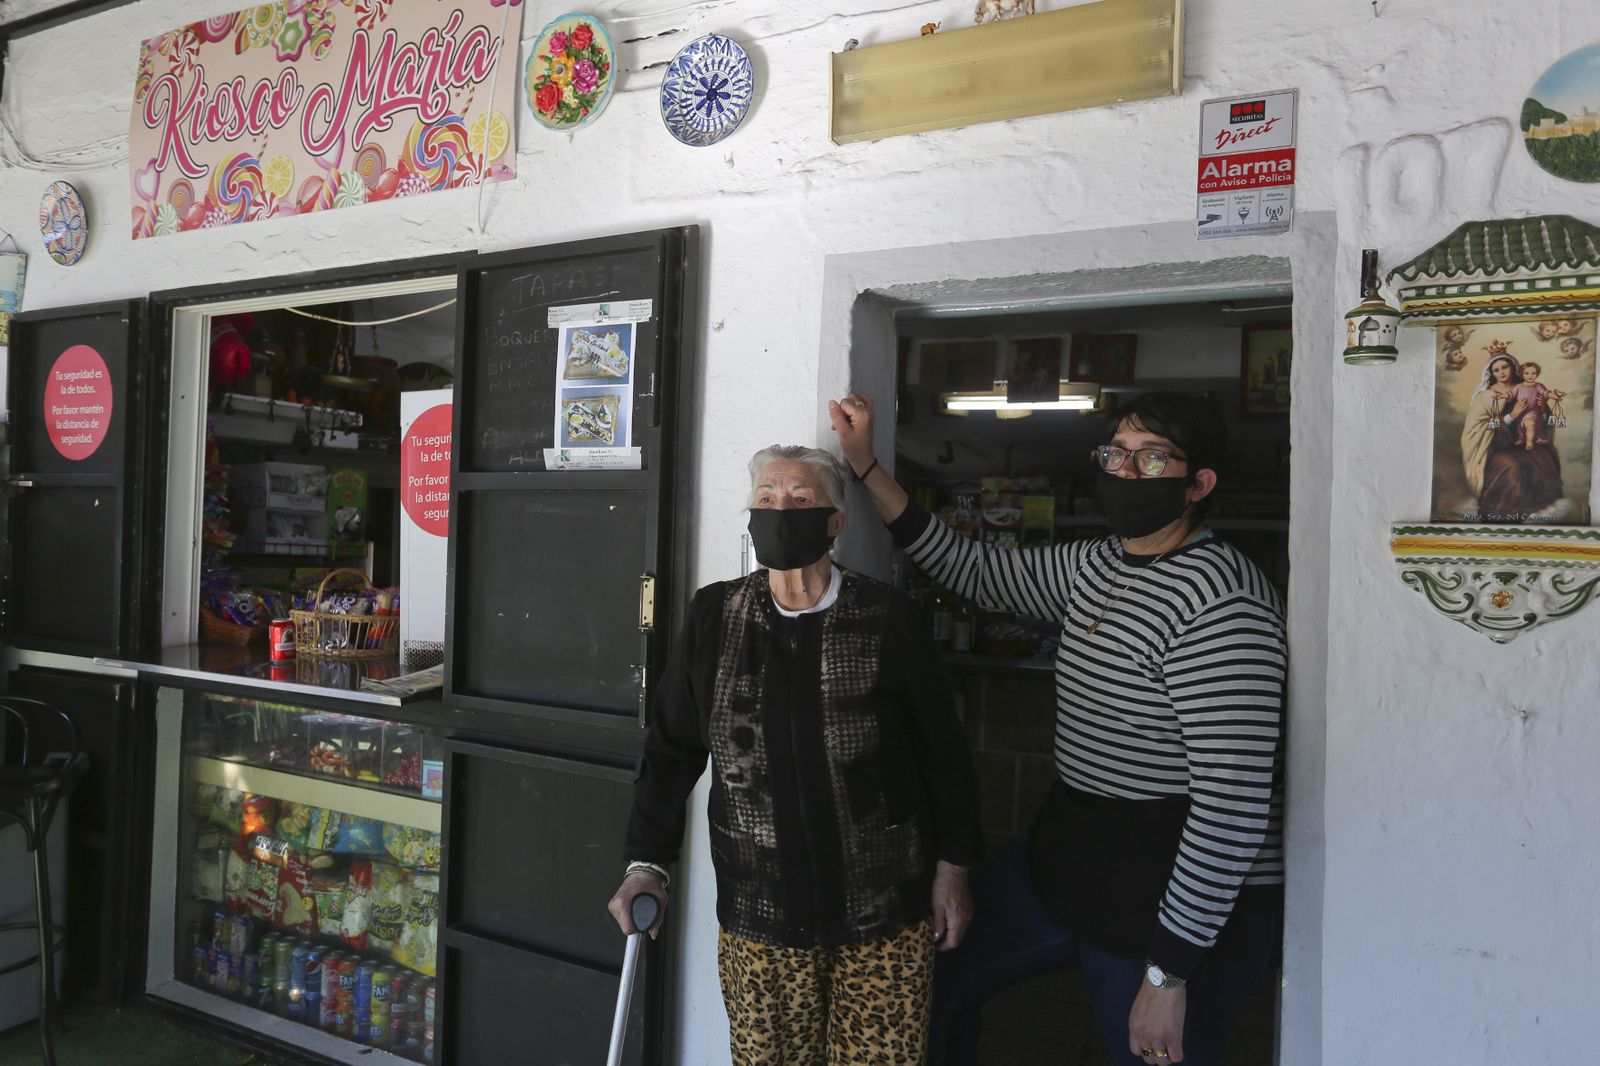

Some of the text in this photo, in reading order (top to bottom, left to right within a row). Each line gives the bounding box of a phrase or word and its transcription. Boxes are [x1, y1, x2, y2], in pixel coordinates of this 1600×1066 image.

[144, 9, 504, 179] Kiosco María
[1231, 114, 1264, 123] SECURITAS
[1215, 117, 1283, 150] Direct
[1201, 158, 1292, 179] Alarma
[1200, 181, 1217, 189] con
[1220, 176, 1247, 187] Aviso
[1258, 172, 1292, 183] Policía
[56, 369, 102, 382] Tu seguridad es
[61, 384, 96, 394] la de todos.
[52, 405, 104, 415] Por favor mantén
[56, 419, 99, 429] la distancia de
[61, 434, 93, 445] seguridad.
[411, 436, 422, 447] Tu
[421, 452, 428, 462] la
[431, 451, 442, 461] de
[409, 474, 448, 487] Por favor
[416, 492, 423, 502] la
